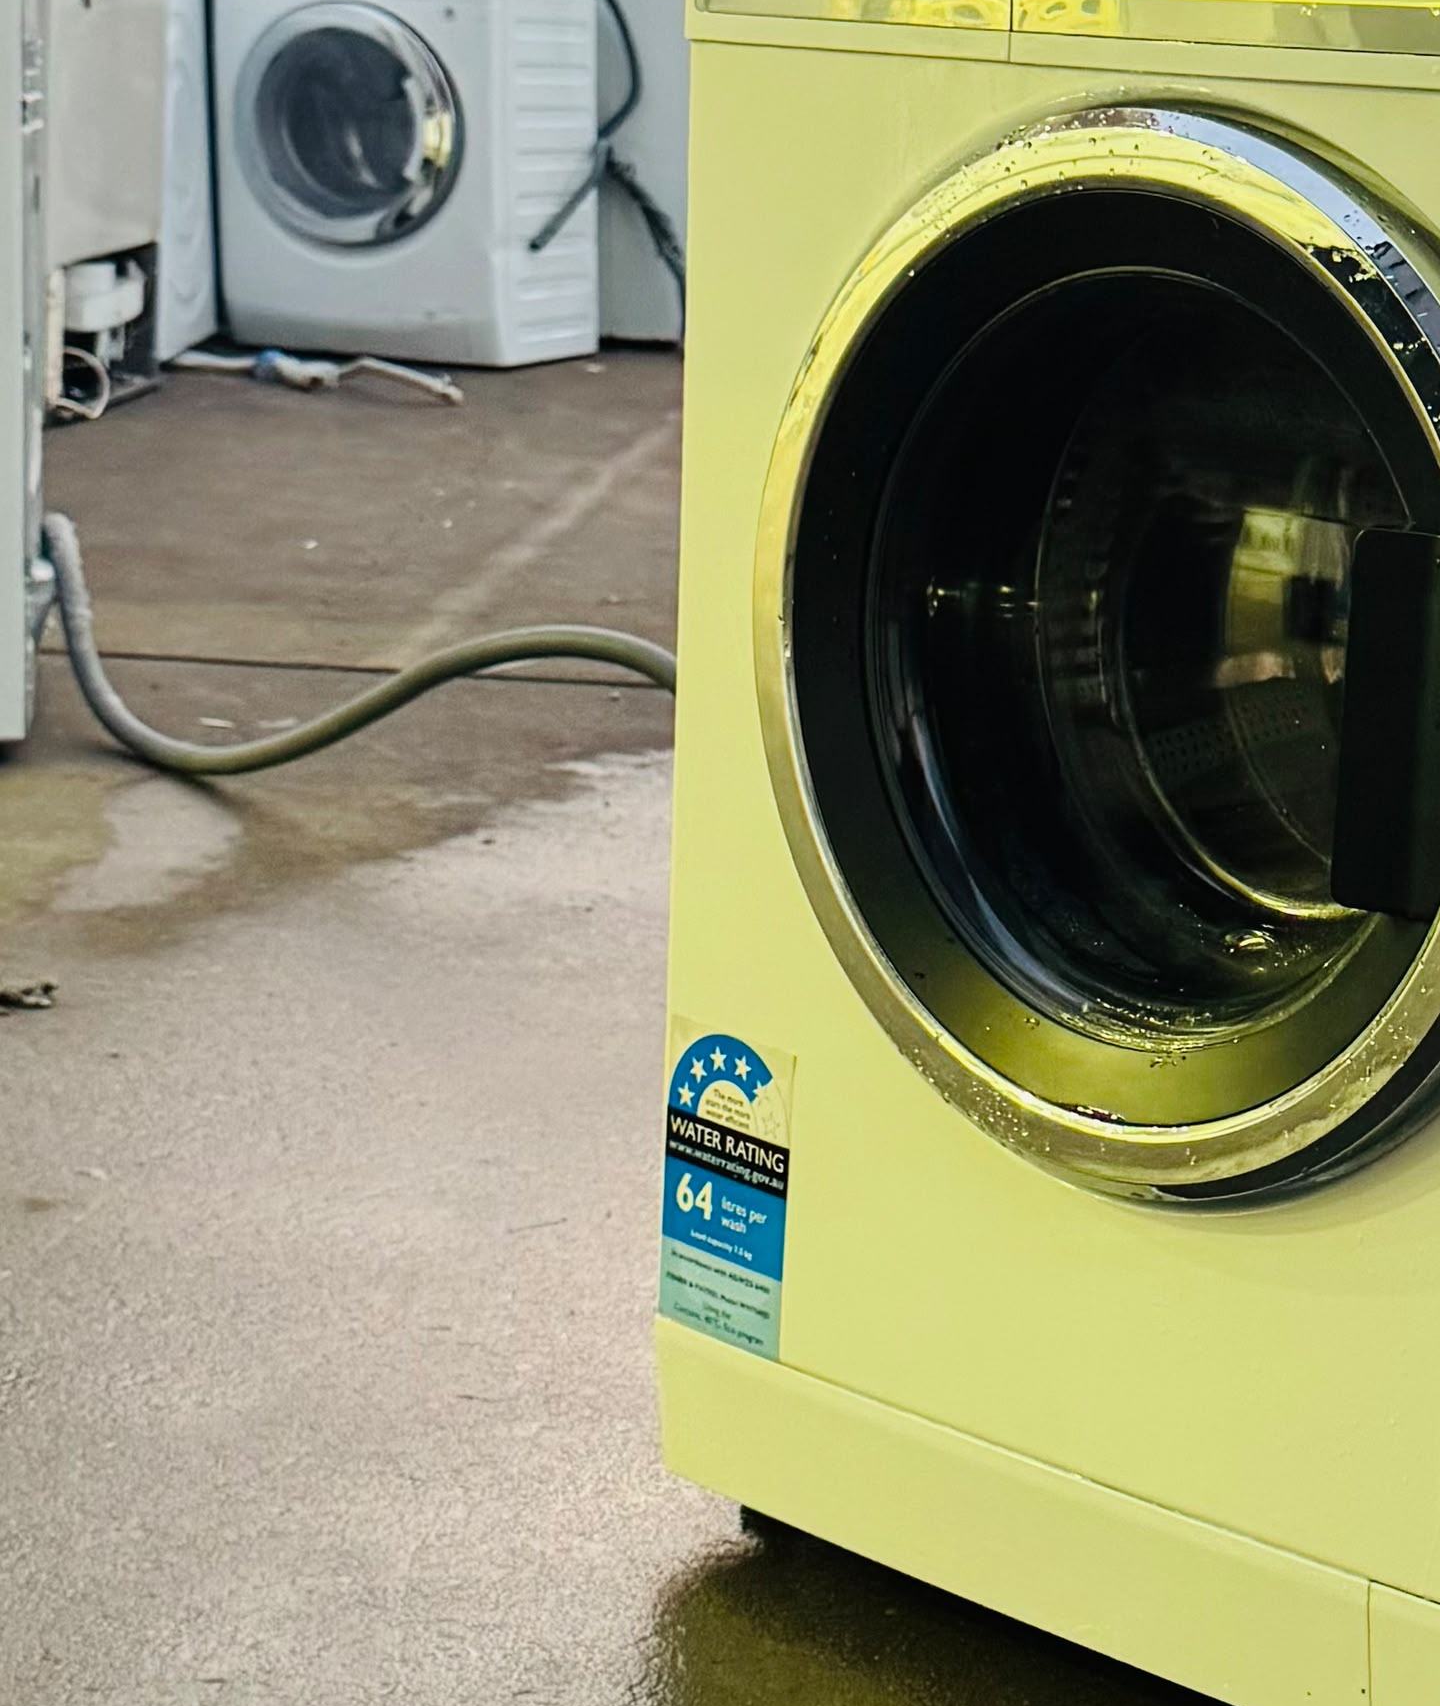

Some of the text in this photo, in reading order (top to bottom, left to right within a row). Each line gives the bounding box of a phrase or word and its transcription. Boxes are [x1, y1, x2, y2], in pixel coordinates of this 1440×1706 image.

[671, 1114, 785, 1173] WATER RATING
[676, 1172, 713, 1221] 64
[748, 1210, 768, 1224] per
